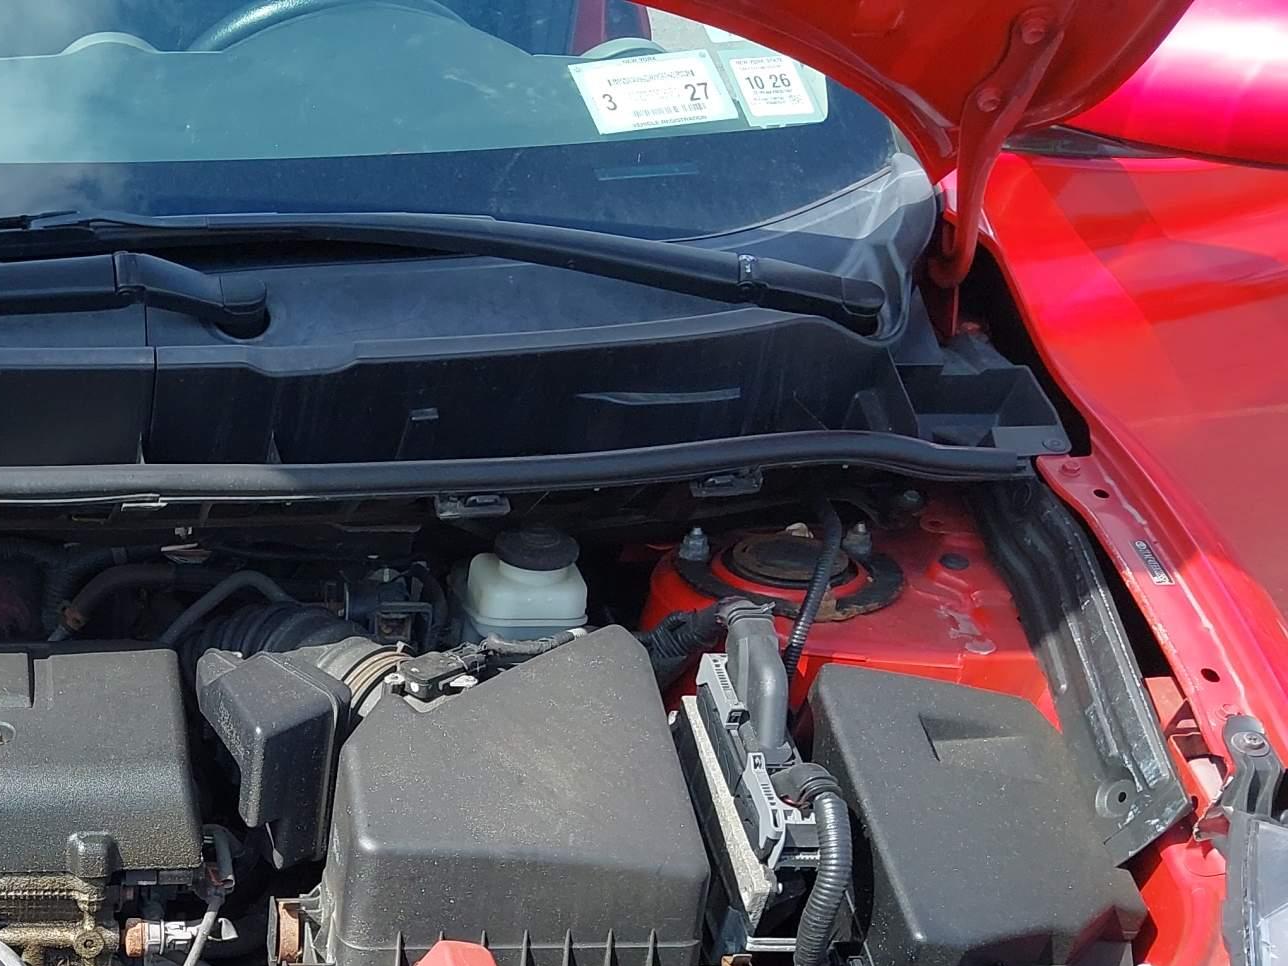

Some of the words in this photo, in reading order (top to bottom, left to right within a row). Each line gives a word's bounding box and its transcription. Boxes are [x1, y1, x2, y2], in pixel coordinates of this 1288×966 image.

[745, 75, 765, 90] 10
[768, 73, 791, 88] 26
[684, 82, 709, 102] 27
[602, 93, 618, 111] 3
